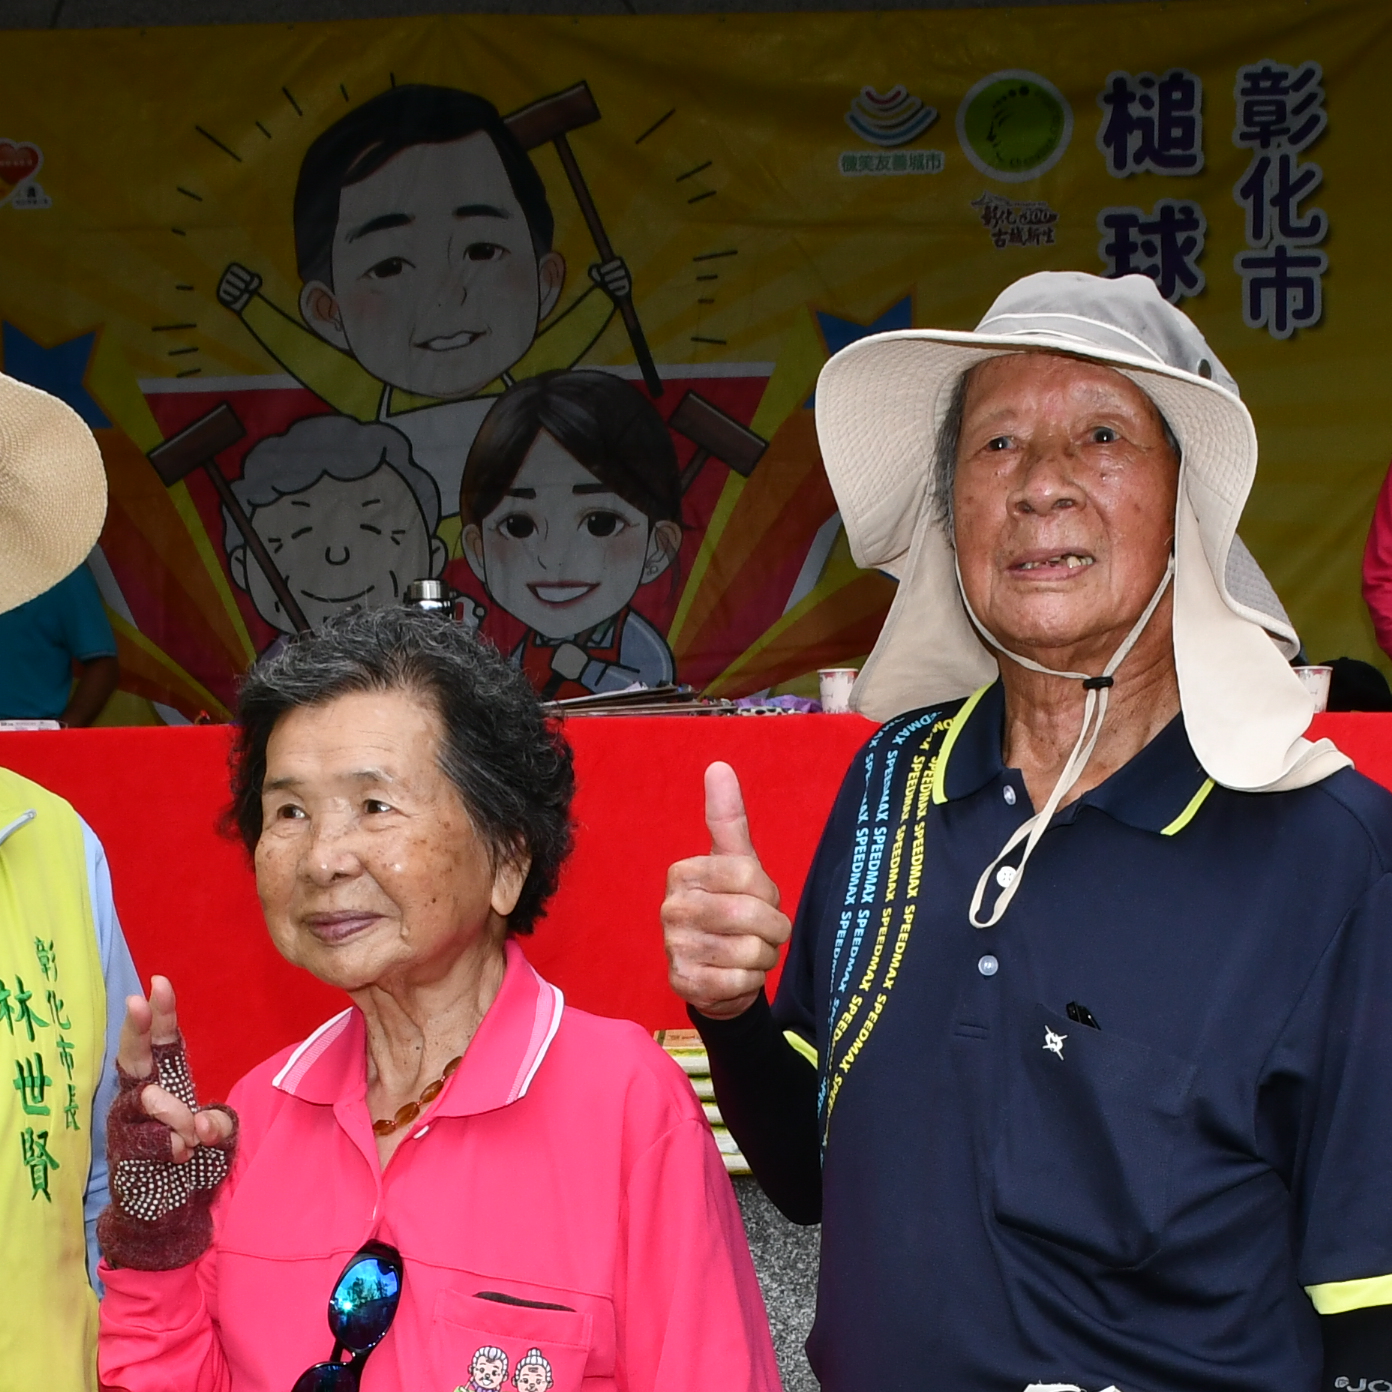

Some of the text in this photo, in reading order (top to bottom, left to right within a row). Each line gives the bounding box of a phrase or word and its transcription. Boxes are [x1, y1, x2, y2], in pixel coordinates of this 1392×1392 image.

[1104, 71, 1203, 299] 槌球
[1238, 65, 1326, 333] 彰化市
[844, 827, 869, 906] SPEEDMAX
[861, 826, 887, 904] SPEEDMAX
[885, 824, 907, 903] SPEEDMAX
[906, 821, 926, 899] SPEEDMAX
[838, 908, 870, 993] SPEEDMAX
[858, 906, 893, 992] SPEEDMAX
[882, 903, 916, 990] SPEEDMAX
[33, 936, 81, 1131] 彰化市長
[839, 992, 887, 1073] SPEEDMAX
